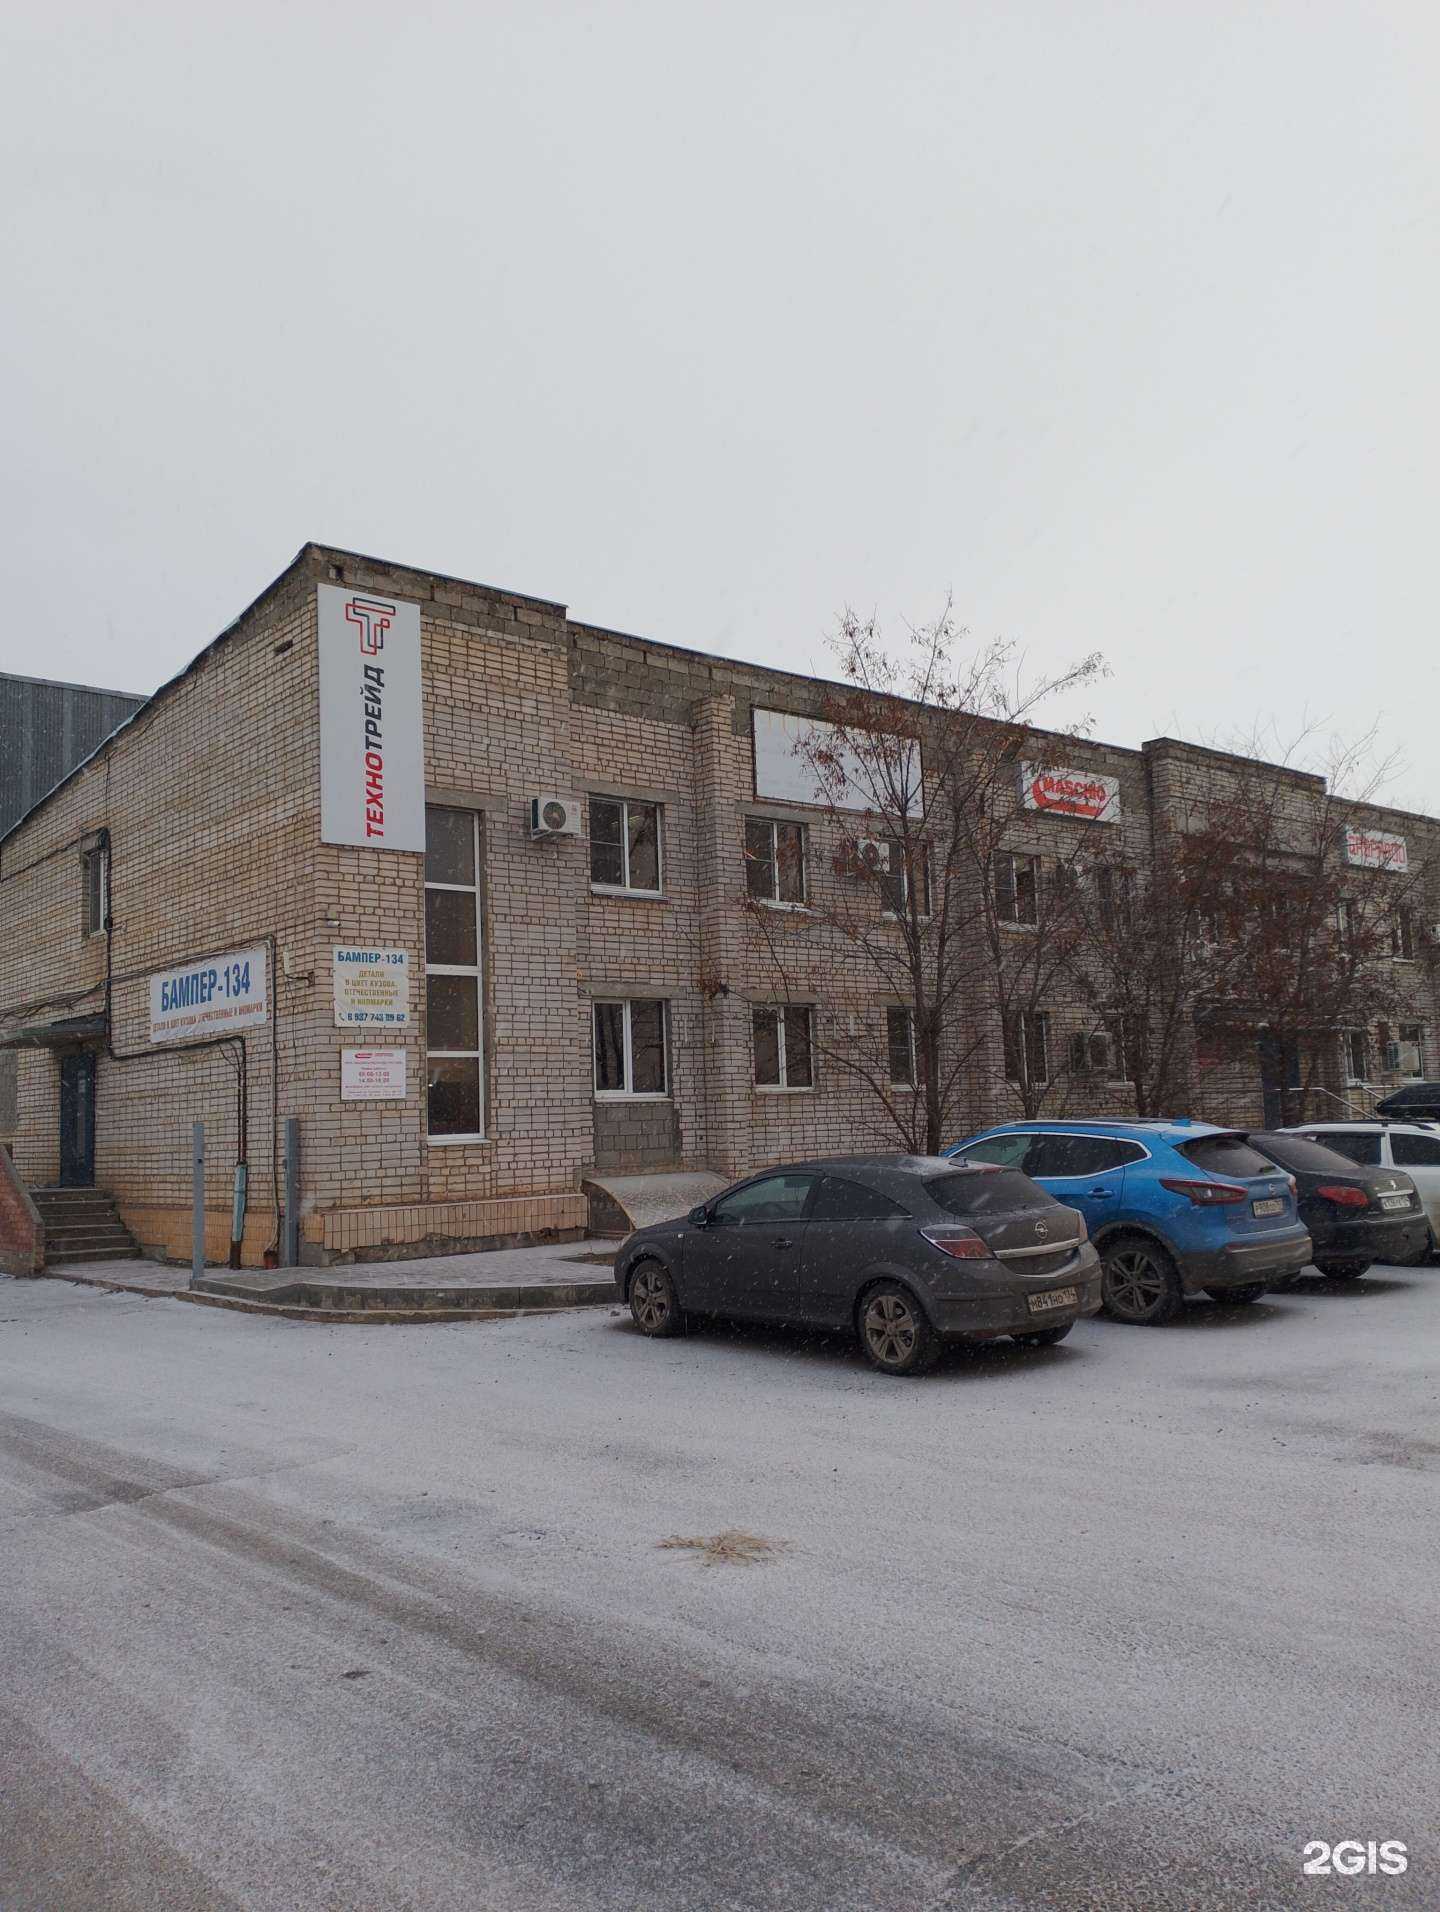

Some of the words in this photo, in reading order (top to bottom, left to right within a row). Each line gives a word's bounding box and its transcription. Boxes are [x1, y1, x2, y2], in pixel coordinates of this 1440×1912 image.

[360, 664, 385, 838] ТЕХНОТРЕЙД
[337, 951, 404, 964] БАМПЕР-134
[161, 961, 251, 1012] БАМПЕР-134
